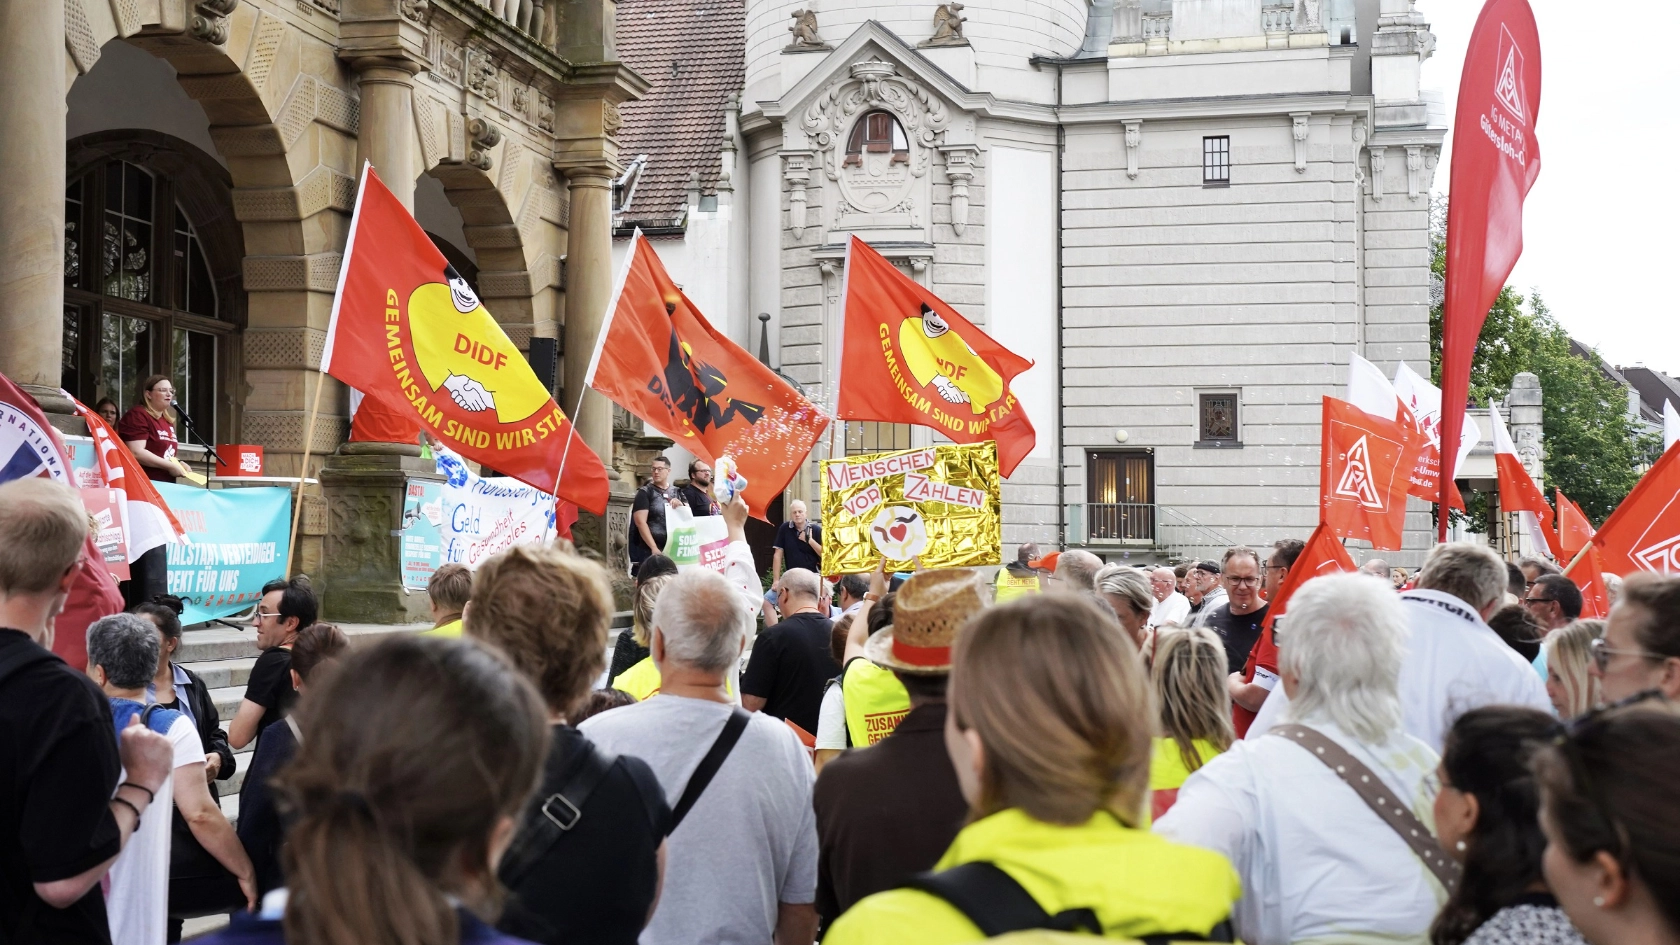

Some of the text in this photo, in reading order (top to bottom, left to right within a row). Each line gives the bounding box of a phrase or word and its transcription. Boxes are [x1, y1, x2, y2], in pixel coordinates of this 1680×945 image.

[1490, 104, 1498, 123] IG
[453, 332, 508, 371] DIDF
[385, 288, 442, 429] GEMEINSAM
[443, 419, 490, 449] SIND
[495, 429, 537, 450] WIR
[879, 322, 932, 414] GEMEINSAM
[931, 407, 964, 432] SIND
[828, 450, 936, 490] MENSCHEN
[408, 484, 425, 497] BASTA!
[844, 488, 881, 515] VOR
[904, 473, 983, 506] ZAHLEN
[452, 503, 482, 534] Geld
[219, 541, 276, 566] VERTEIDIGEN
[447, 537, 465, 563] für
[195, 565, 218, 593] FÜR
[218, 569, 240, 592] UNS
